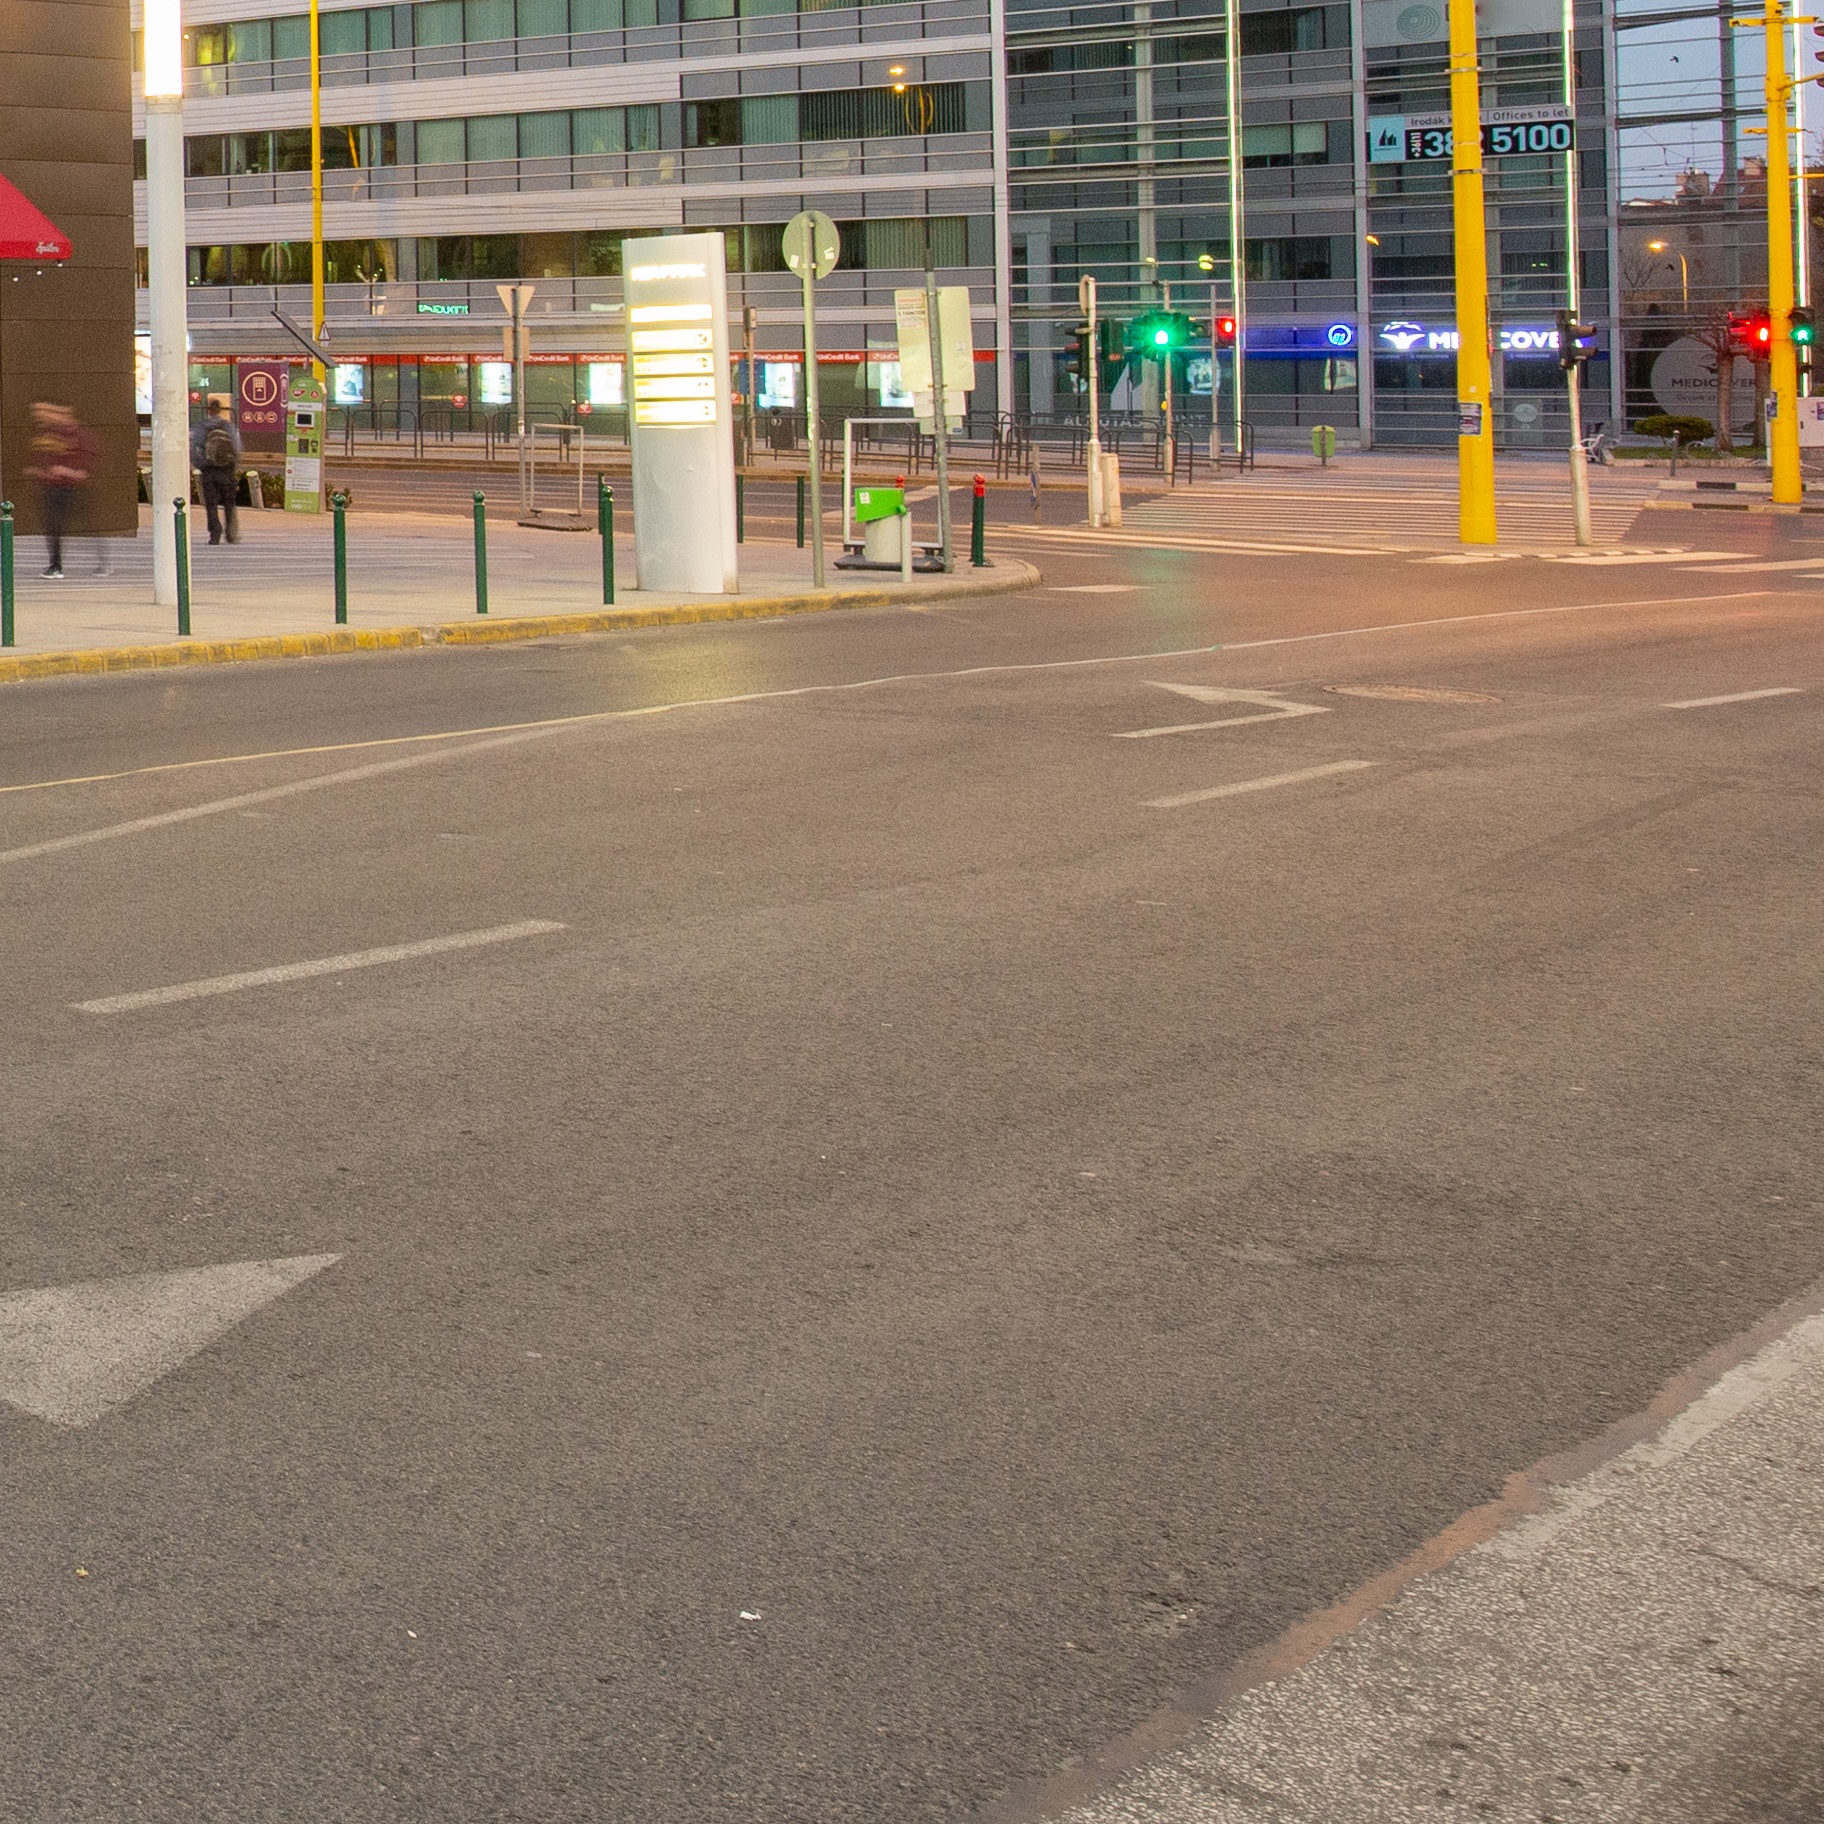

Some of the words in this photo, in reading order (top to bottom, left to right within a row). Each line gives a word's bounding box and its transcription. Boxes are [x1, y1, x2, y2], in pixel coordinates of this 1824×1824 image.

[1411, 116, 1444, 126] Irodák
[1493, 111, 1533, 121] Offices
[1537, 110, 1548, 119] to
[1553, 108, 1569, 117] let
[1492, 123, 1570, 152] 5100
